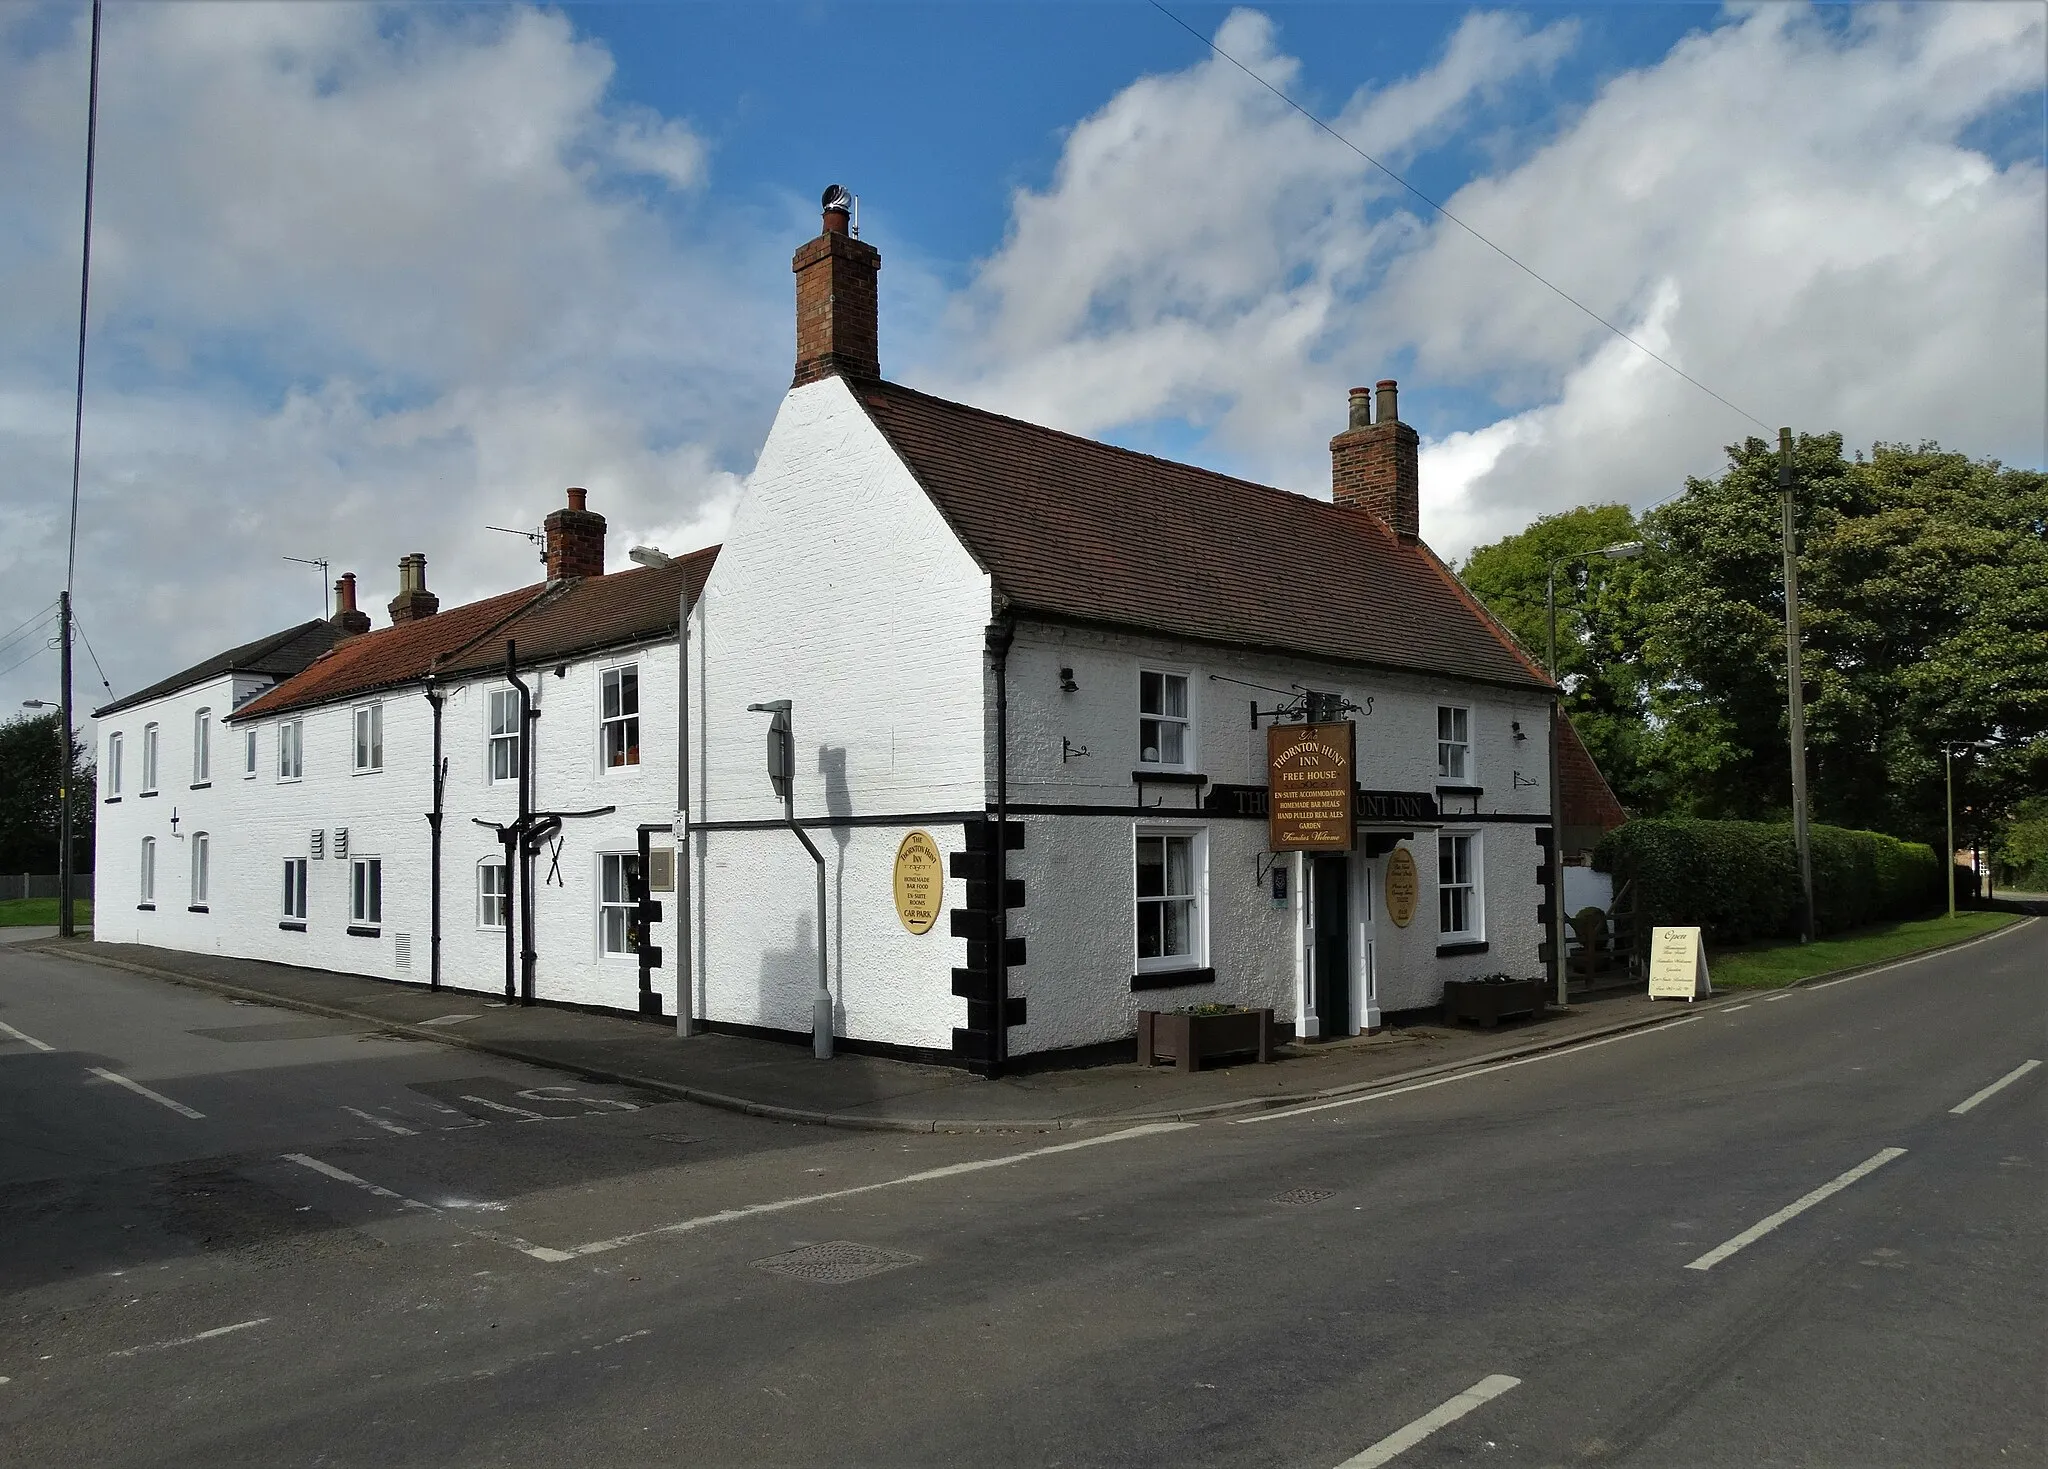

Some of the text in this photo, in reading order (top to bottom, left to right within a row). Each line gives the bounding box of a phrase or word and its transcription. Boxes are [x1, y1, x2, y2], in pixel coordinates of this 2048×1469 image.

[1273, 742, 1346, 769] THORNTON HUNT
[1300, 757, 1319, 766] INN
[1283, 771, 1337, 781] FREE HOUSE
[1299, 790, 1345, 798] ACCOMMODATION
[1393, 796, 1423, 817] INN
[1311, 831, 1340, 840] Welcome
[901, 845, 936, 863] THORNTON HUNT
[916, 910, 932, 918] PARK
[1664, 929, 1687, 942] Open
